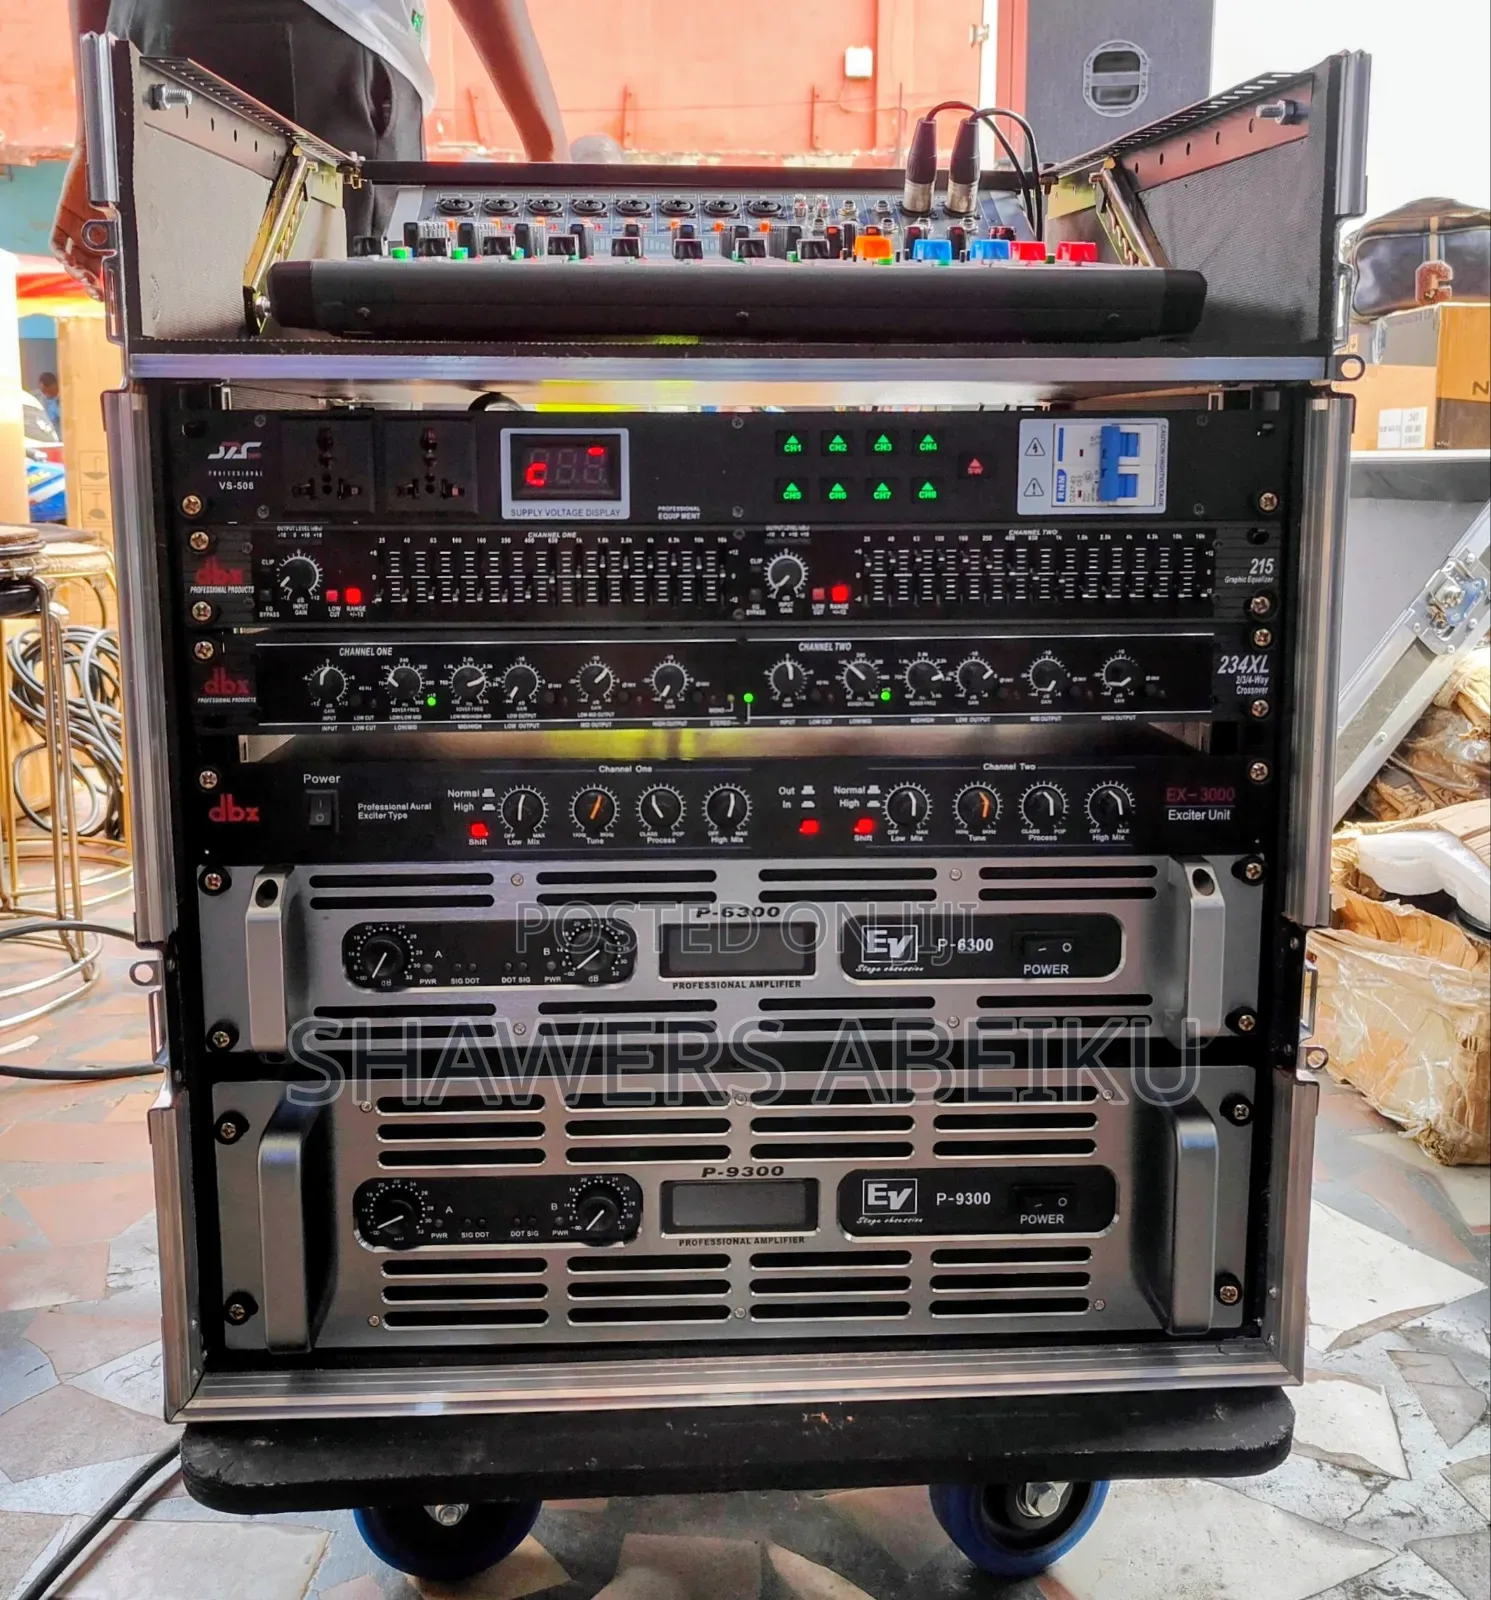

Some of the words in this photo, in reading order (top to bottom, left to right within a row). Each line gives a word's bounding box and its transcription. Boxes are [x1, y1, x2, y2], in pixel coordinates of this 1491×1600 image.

[784, 444, 802, 452] CH1
[828, 444, 847, 452] CH2
[874, 443, 892, 452] CH3
[919, 442, 937, 451] CH4
[1056, 474, 1065, 500] RNM
[783, 492, 802, 500] CH5
[828, 492, 847, 500] CH6
[874, 491, 892, 500] CH7
[918, 490, 937, 499] CH8
[510, 508, 545, 517] SUPPLY
[547, 508, 586, 517] VOLTAGE
[587, 508, 621, 517] DISPLAY
[195, 555, 243, 584] dbx
[1250, 558, 1274, 574] 215
[1224, 576, 1246, 584] Graphic
[1247, 574, 1274, 583] Equalizer
[190, 586, 226, 594] PROFESSIONAL
[228, 586, 255, 594] PRODUCTS
[339, 647, 376, 656] CHANNEL
[376, 647, 393, 656] ONE
[798, 642, 834, 652] CHANNEL
[834, 642, 852, 652] TWO
[1217, 654, 1270, 674] 234XL
[204, 667, 250, 696] dbx
[1236, 676, 1270, 686] 2/3/4-Way
[1236, 686, 1268, 695] Crossover
[303, 774, 340, 784] Power
[448, 789, 480, 798] Normal
[778, 786, 796, 795] Out
[834, 786, 866, 794] Normal
[208, 794, 260, 822] dbx
[358, 802, 409, 812] Professional
[410, 802, 432, 812] Aural
[454, 802, 474, 812] High
[782, 800, 792, 808] In
[840, 800, 860, 808] High
[358, 812, 386, 820] Exciter
[388, 812, 408, 820] Type
[1168, 810, 1206, 820] Exciter
[1208, 809, 1230, 820] Unit
[696, 906, 780, 918] P-6300
[938, 938, 994, 952] P-6300
[434, 950, 443, 958] A
[543, 948, 550, 956] B
[1023, 964, 1069, 975] POWER
[588, 974, 599, 982] dB
[672, 981, 746, 990] PROFESSIONAL
[748, 980, 802, 989] AMPLIFIER
[701, 1166, 784, 1178] P-9300
[936, 1192, 991, 1206] P-9300
[550, 1202, 558, 1210] B
[1020, 1214, 1064, 1225] POWER
[678, 1238, 751, 1246] PROFESSIONAL
[754, 1236, 805, 1245] AMPLIFIER
